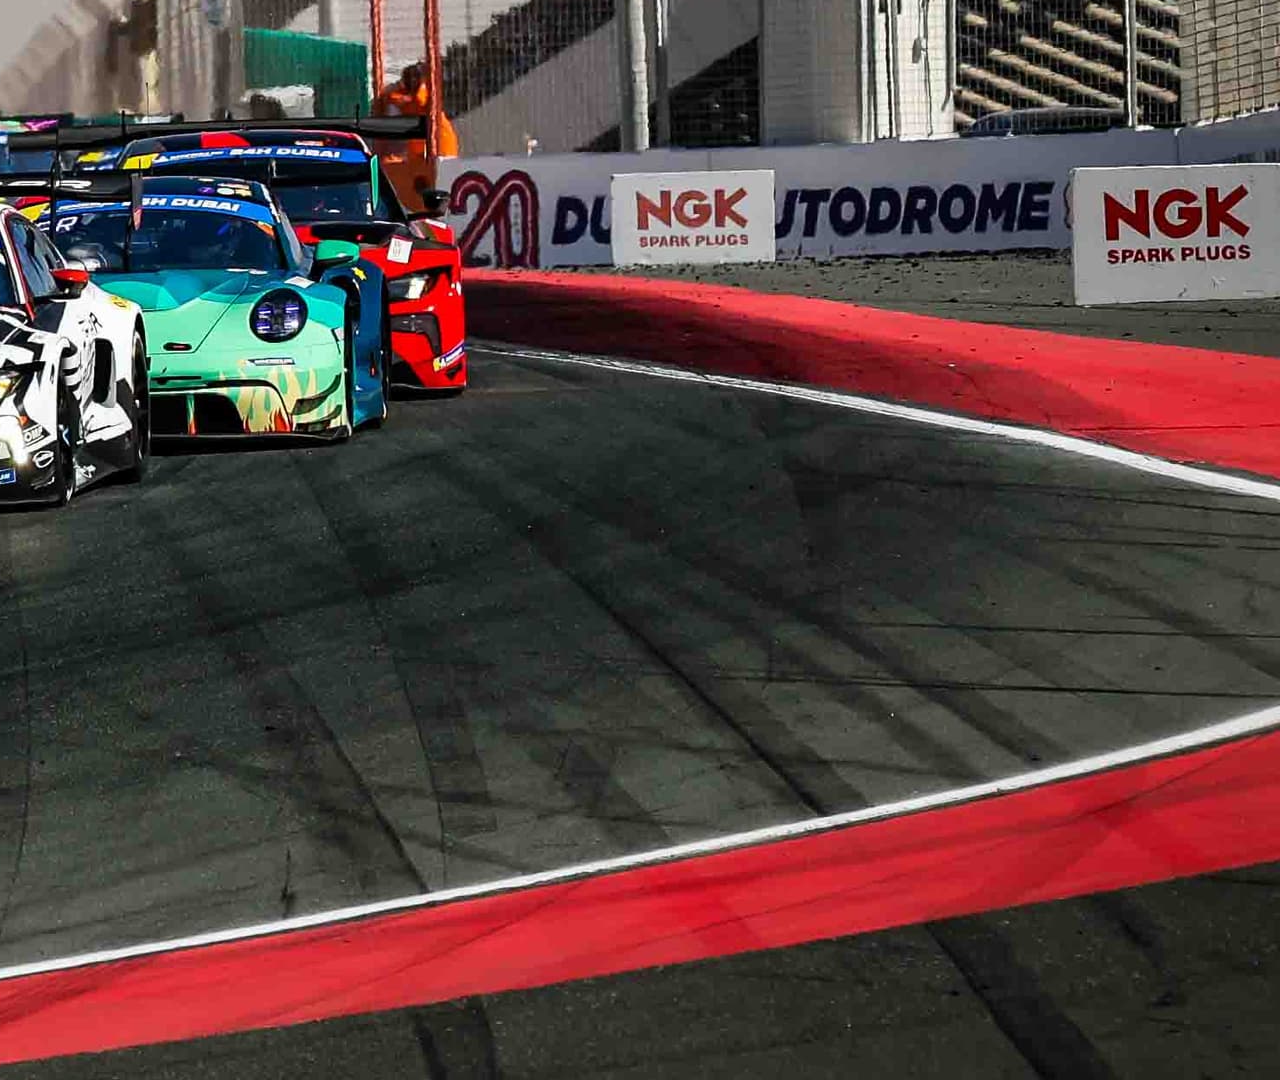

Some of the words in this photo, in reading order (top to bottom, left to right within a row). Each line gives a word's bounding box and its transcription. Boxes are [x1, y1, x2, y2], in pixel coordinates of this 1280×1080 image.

[275, 148, 341, 159] DUBAI
[171, 198, 240, 212] DUBAI
[636, 187, 749, 230] NGK
[1103, 184, 1251, 241] NGK
[449, 169, 539, 267] 20
[775, 181, 1056, 240] UTODROME
[639, 236, 691, 248] SPARK
[695, 234, 749, 247] PLUGS
[1106, 247, 1175, 264] SPARK
[1181, 244, 1251, 262] PLUGS
